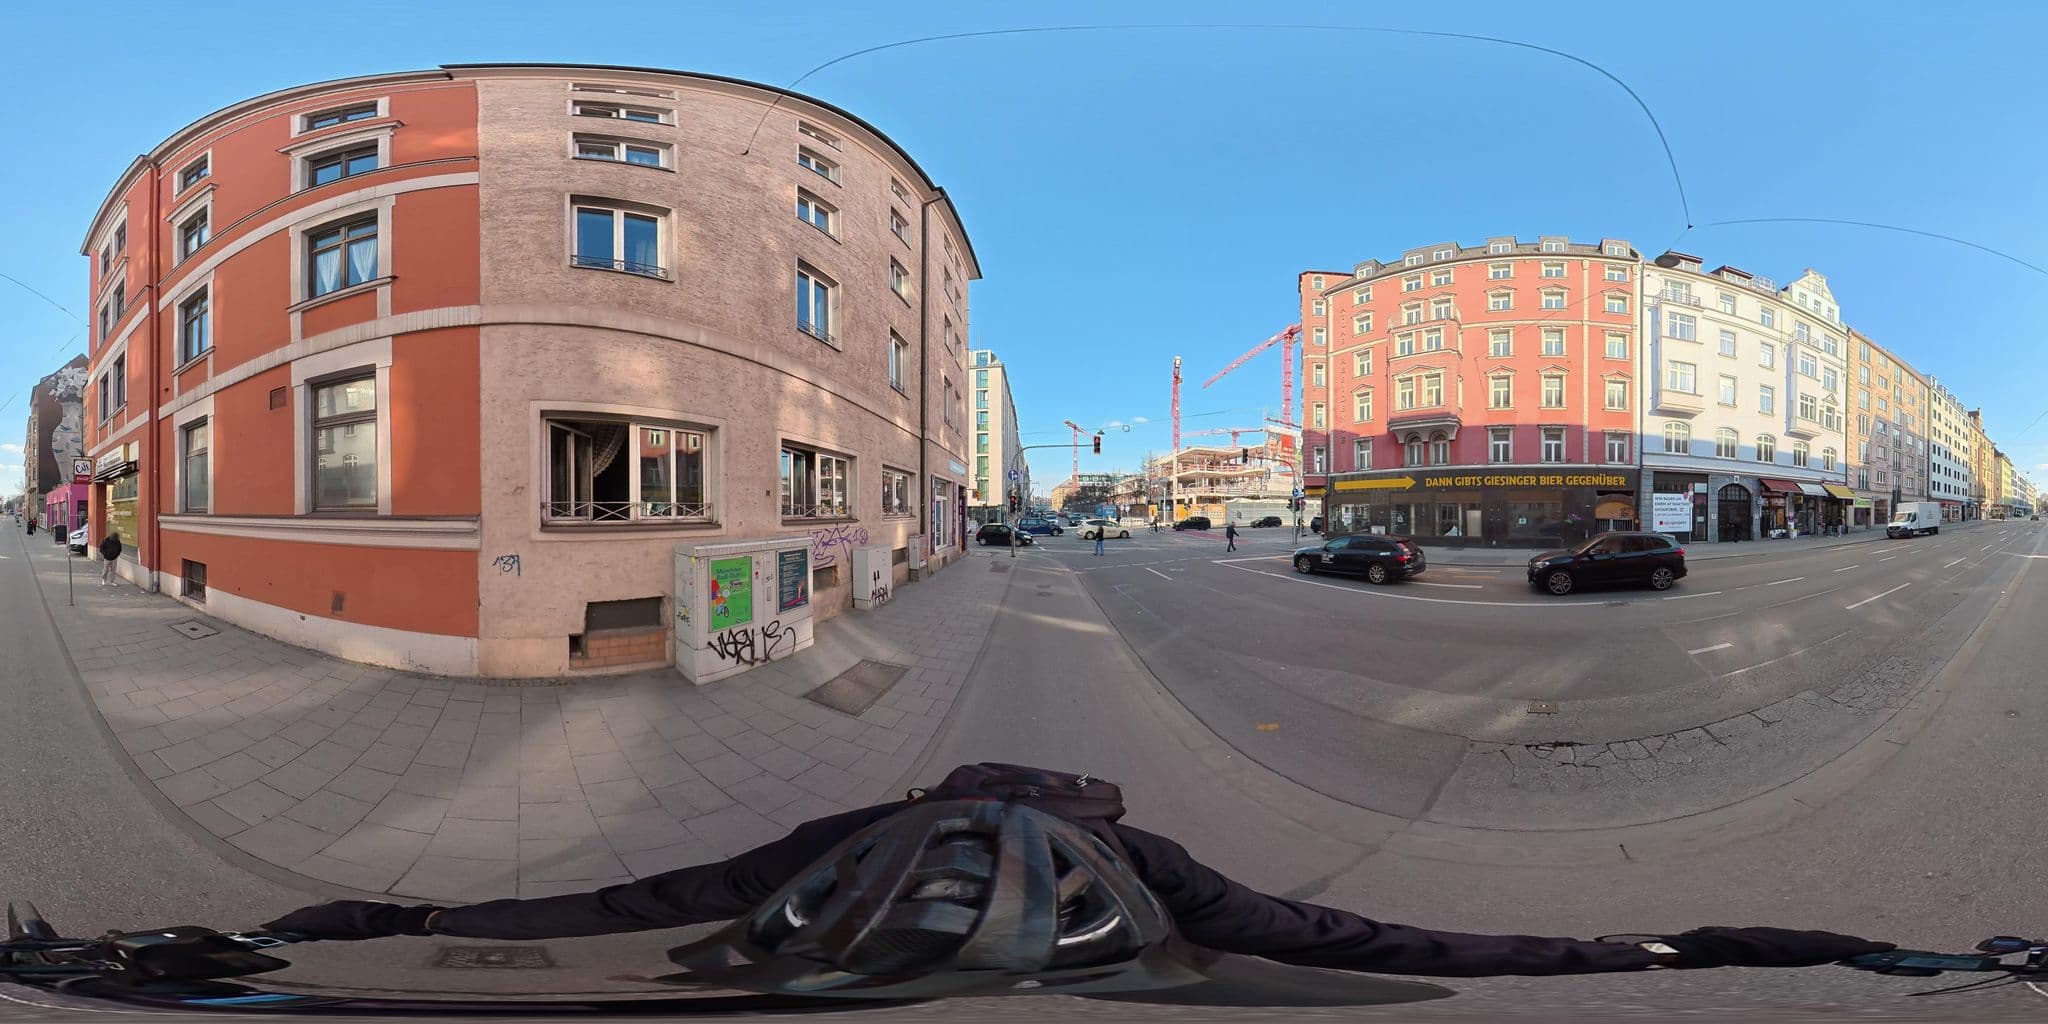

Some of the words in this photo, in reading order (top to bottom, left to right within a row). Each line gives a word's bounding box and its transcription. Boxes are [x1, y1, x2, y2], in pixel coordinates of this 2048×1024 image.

[1425, 477, 1453, 487] DANN
[1455, 476, 1482, 486] GIBTS
[1484, 475, 1537, 486] GIESINGER
[1539, 475, 1563, 486] BIER
[1566, 473, 1626, 486] GEGENÜBER
